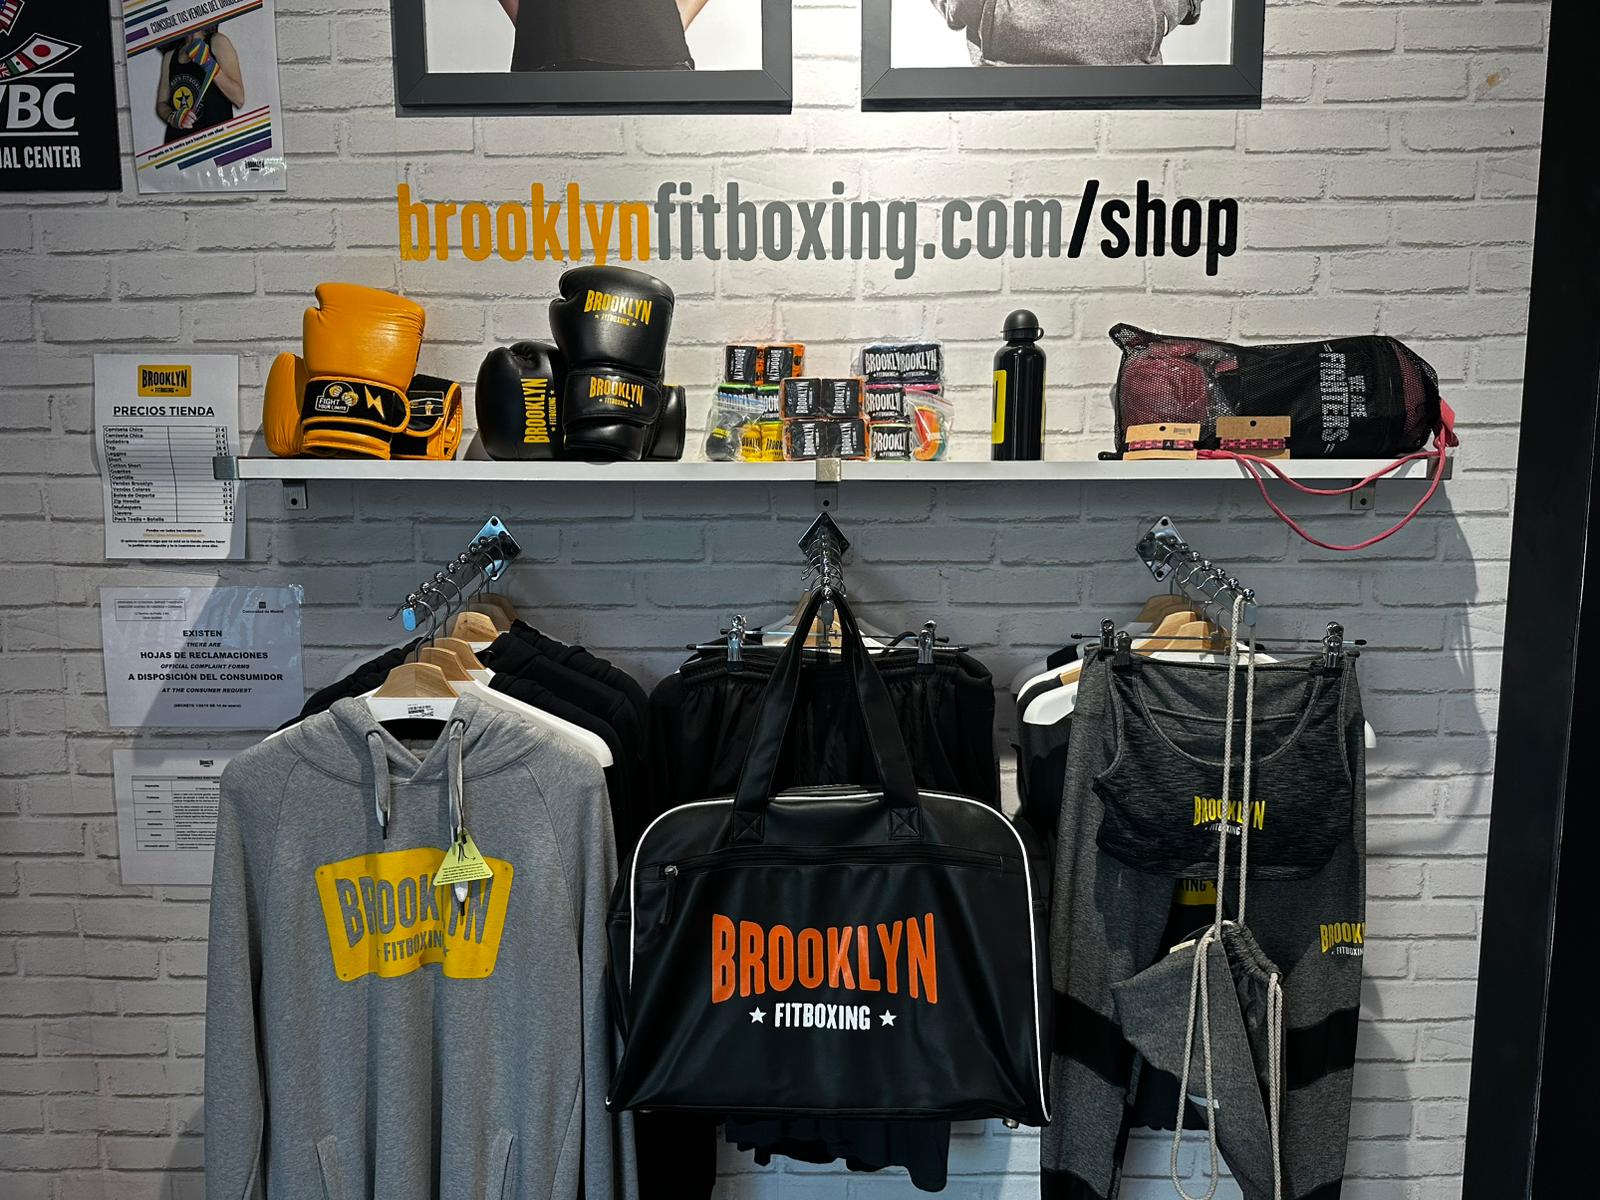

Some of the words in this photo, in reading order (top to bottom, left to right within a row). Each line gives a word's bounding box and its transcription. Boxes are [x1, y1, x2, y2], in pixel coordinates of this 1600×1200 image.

[150, 15, 178, 33] CONSIGUE
[176, 10, 189, 24] TUS
[186, 2, 209, 19] VENDAS
[24, 145, 81, 168] CENTER
[397, 180, 1238, 279] brooklynfitboxing.com/shop
[583, 289, 653, 325] BROOKLYN
[142, 369, 187, 389] BROOKLYN
[733, 349, 746, 381] BROOKLYN
[769, 349, 783, 381] BROOKLYN
[319, 397, 340, 406] FIGHT
[589, 376, 644, 407] BROOKLYN
[795, 381, 809, 414] BROOKLYN
[832, 381, 847, 414] BROOKLYN
[1319, 353, 1350, 441] FIGHTERS
[113, 406, 166, 416] PRECIOS
[169, 406, 215, 416] TIENDA
[520, 378, 551, 443] BROOKLYN
[802, 423, 817, 455] BROOKLYN
[839, 422, 854, 455] BROOKLYN
[128, 673, 135, 681] A
[137, 672, 197, 681] DISPOSICIÓN
[200, 673, 217, 681] DEL
[220, 673, 283, 681] CONSUMIDOR
[712, 912, 938, 1005] BROOKLYN
[774, 1002, 871, 1030] FITBOXING
